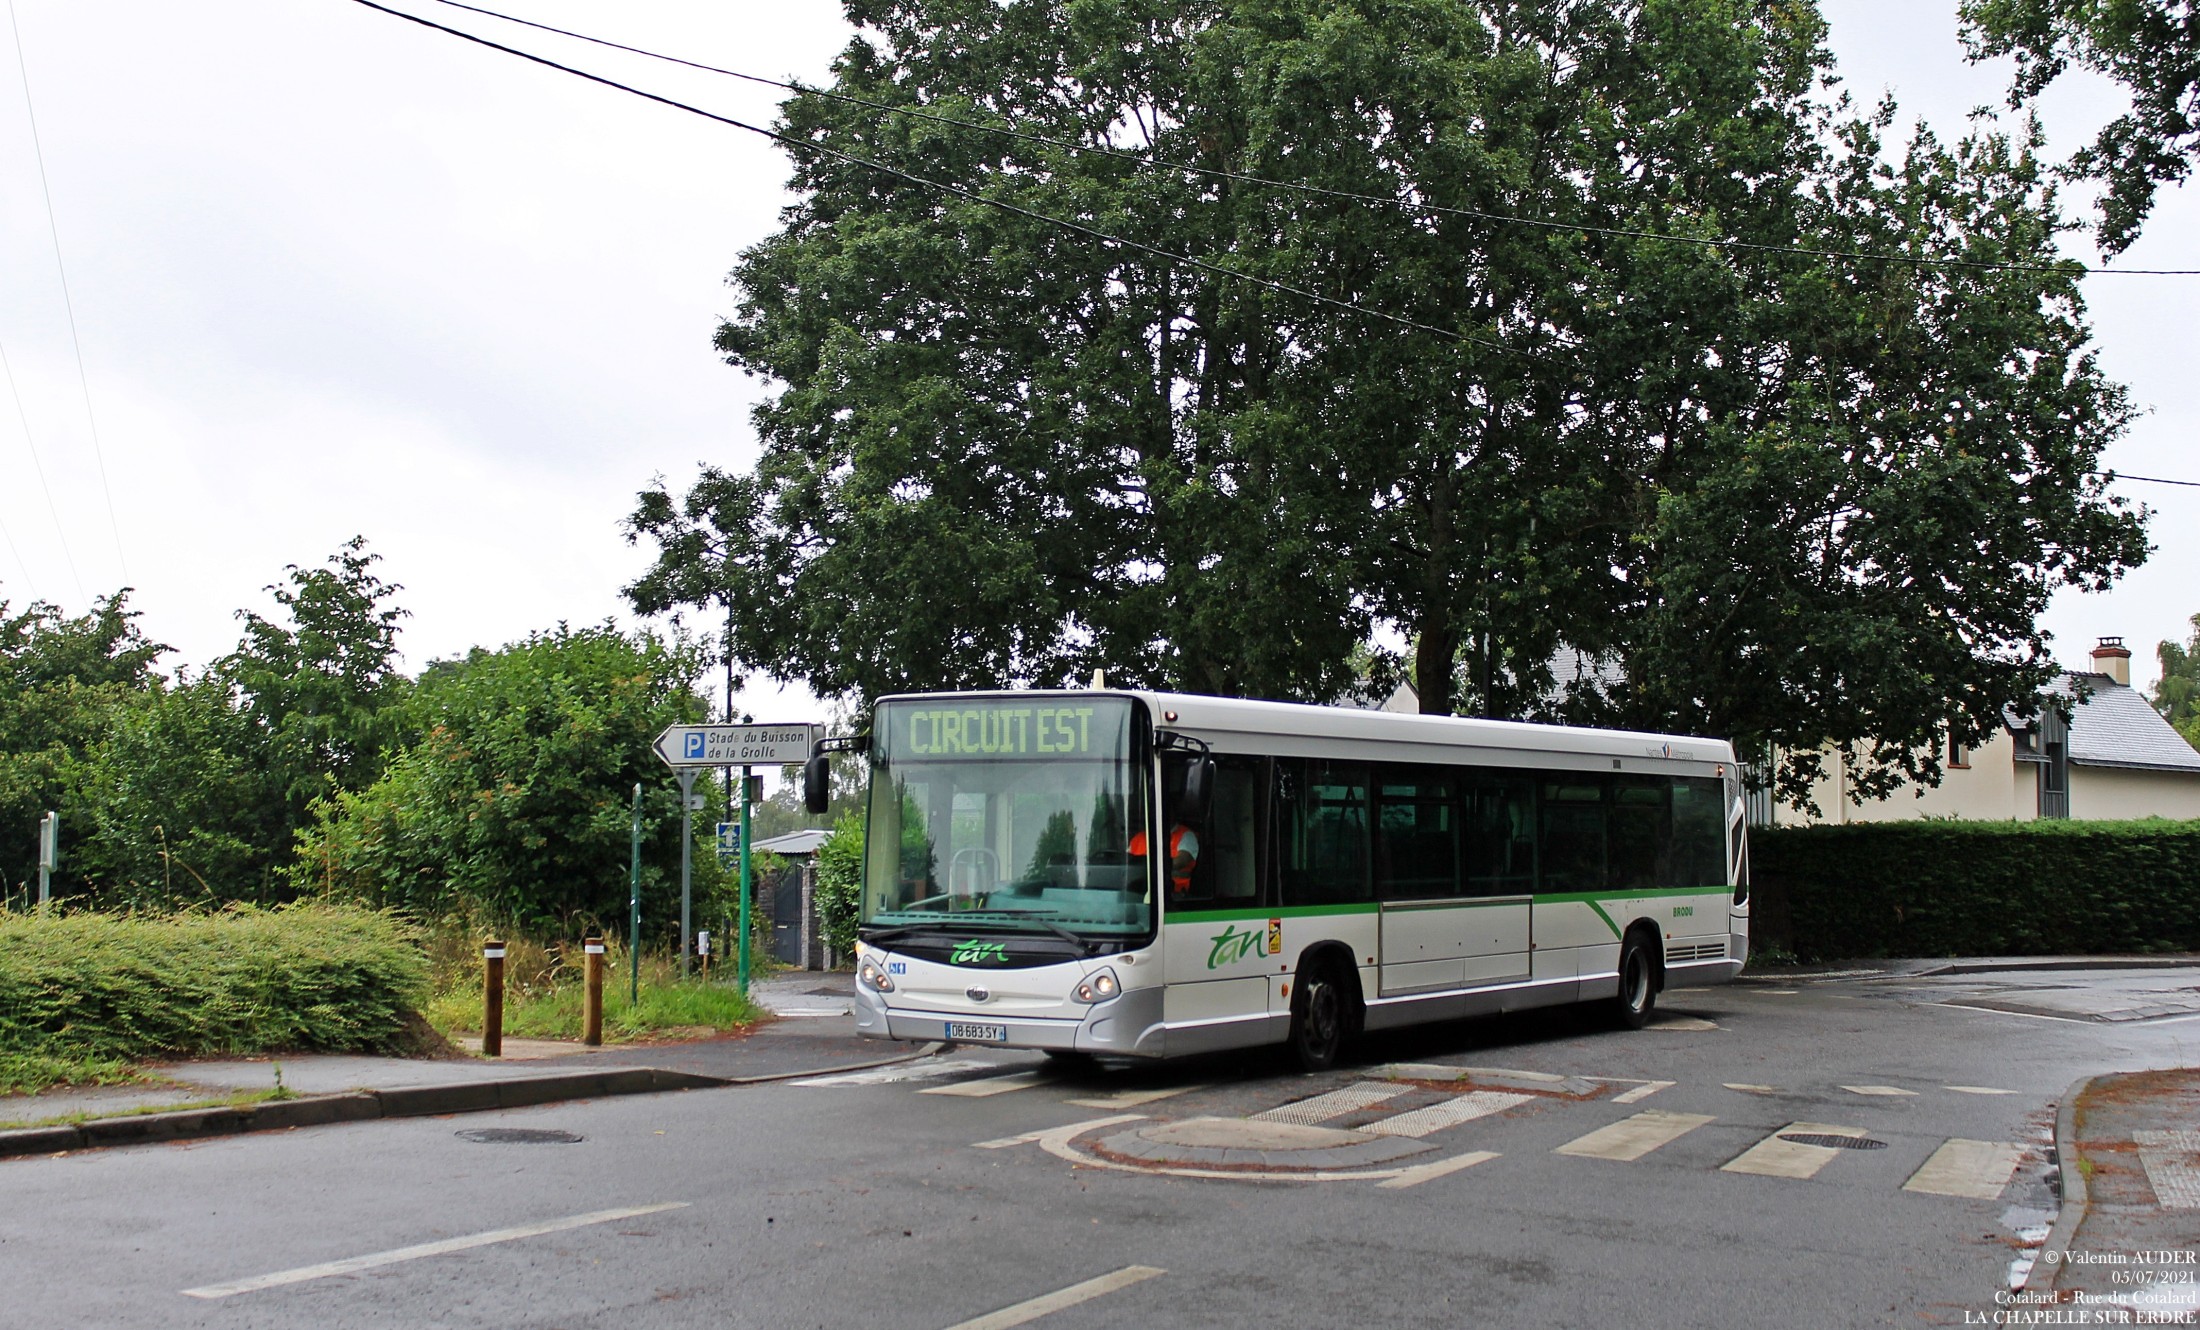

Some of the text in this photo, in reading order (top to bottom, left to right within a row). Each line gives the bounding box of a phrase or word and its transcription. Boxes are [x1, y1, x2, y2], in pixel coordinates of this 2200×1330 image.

[708, 731, 804, 744] Stade du Buisson
[910, 708, 1094, 753] CIRCUIT EST
[708, 747, 721, 759] de
[725, 747, 736, 758] la
[950, 939, 1009, 965] tan
[1207, 925, 1268, 970] tan
